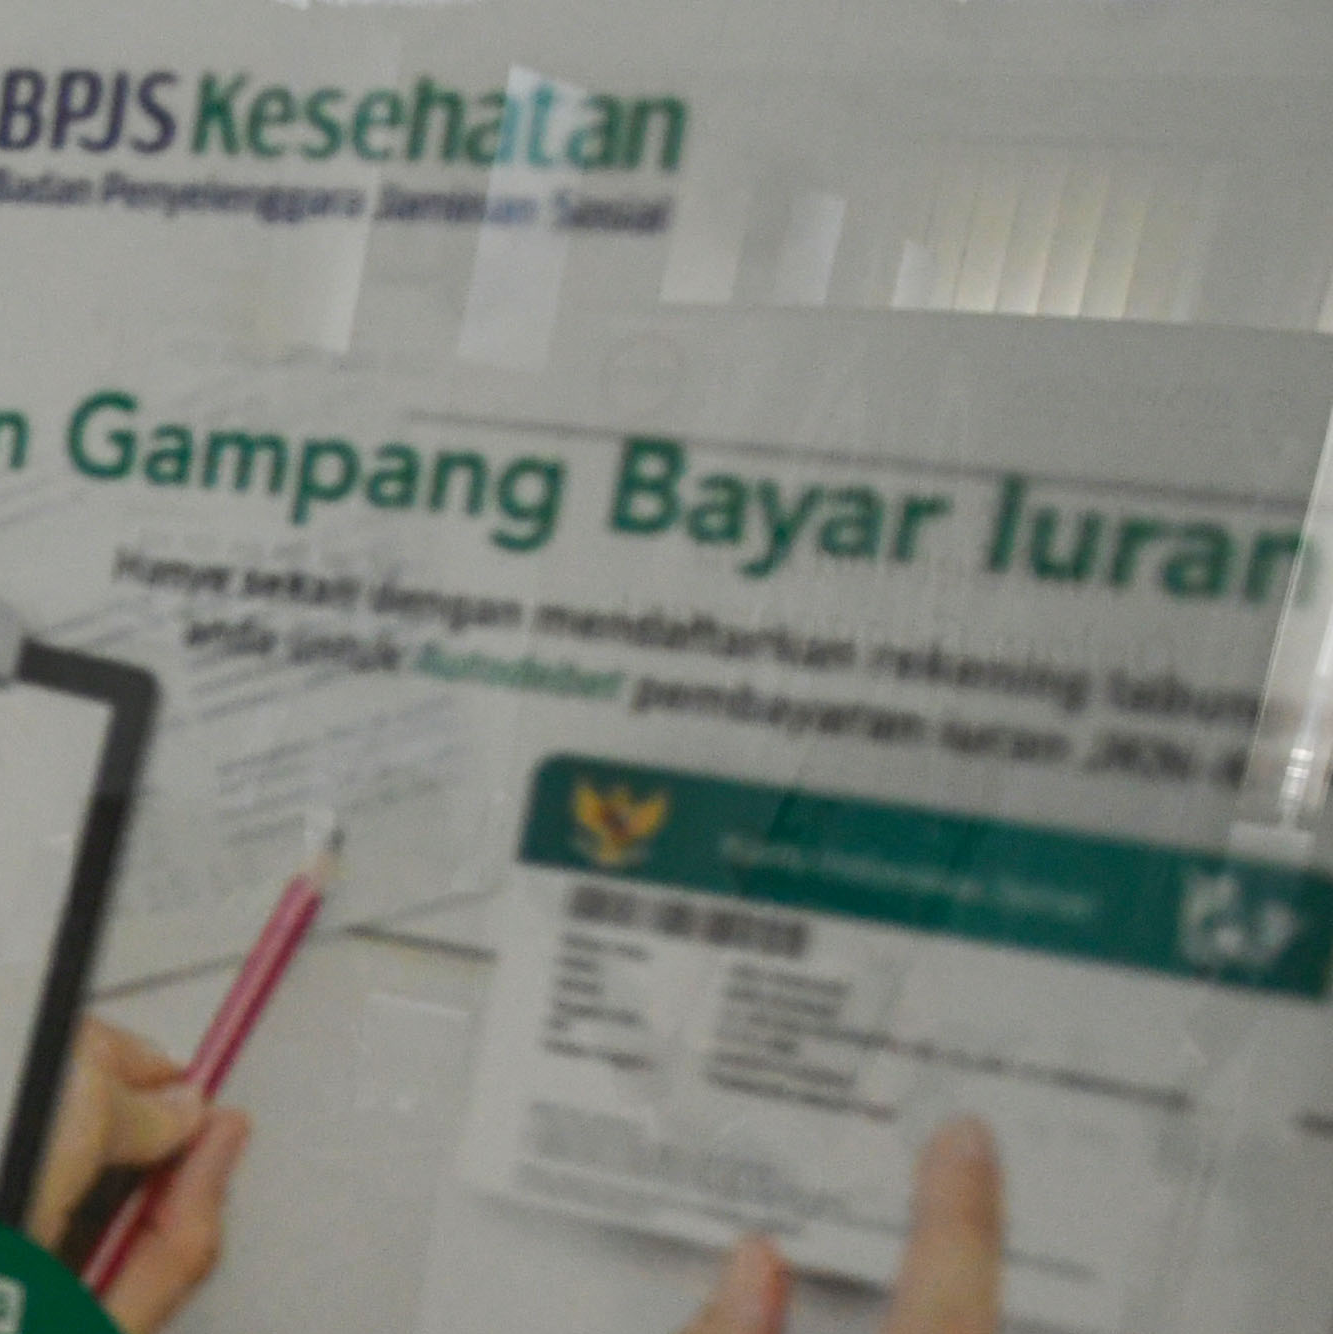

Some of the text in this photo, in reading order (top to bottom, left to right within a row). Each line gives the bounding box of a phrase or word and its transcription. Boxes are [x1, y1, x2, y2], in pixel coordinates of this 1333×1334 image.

[190, 73, 688, 172] Kesehatan
[65, 391, 565, 552] Gampang
[609, 434, 952, 576] Bayar
